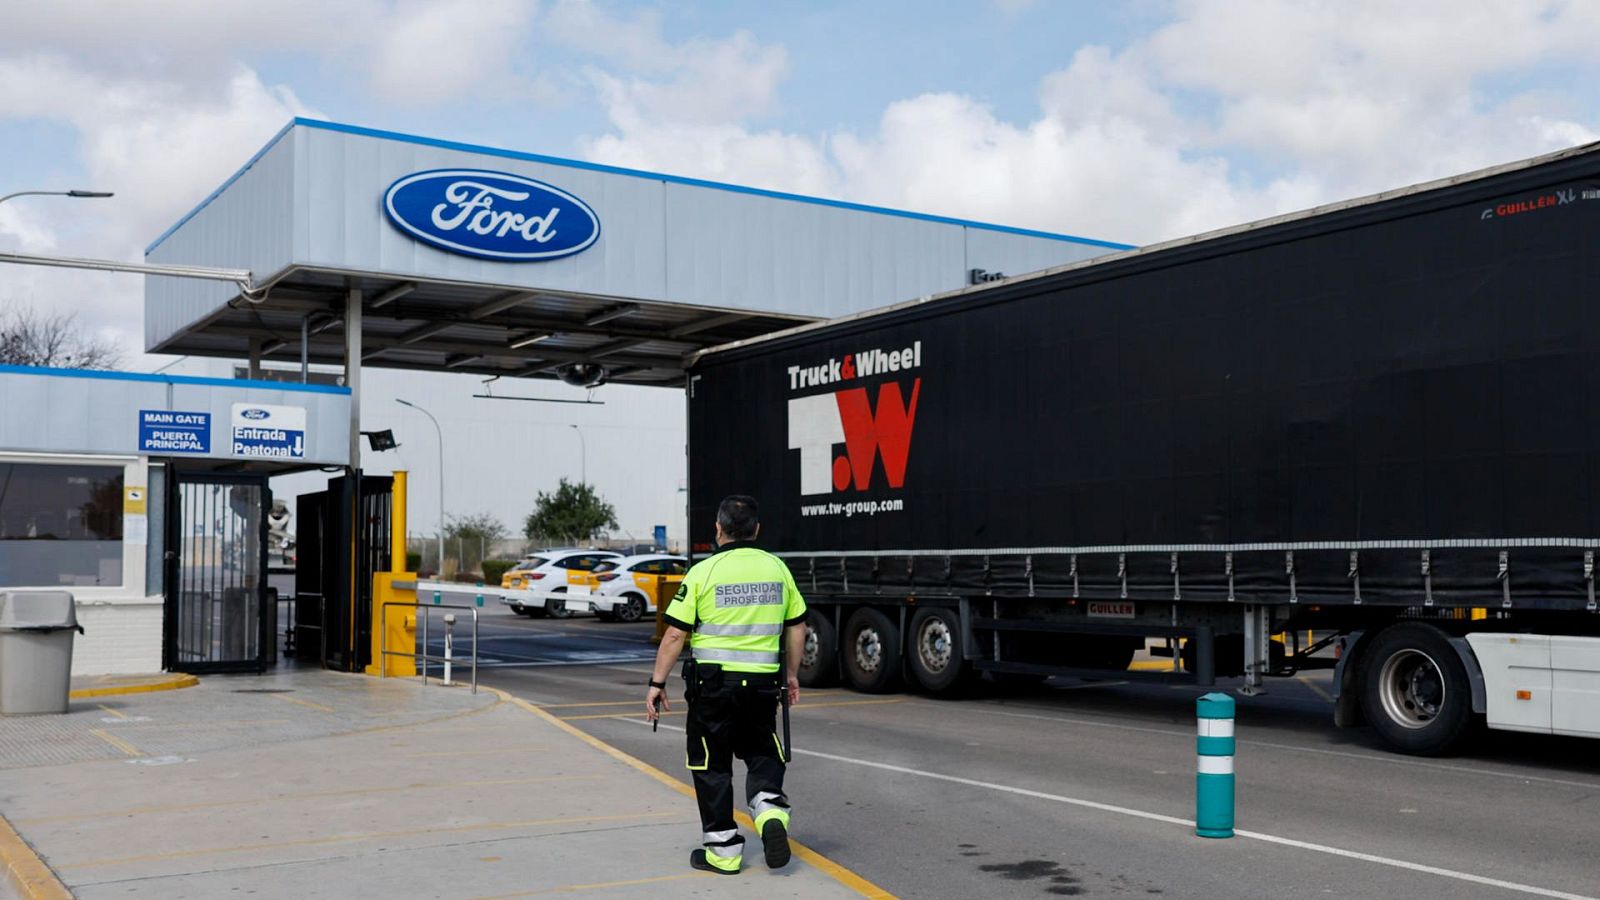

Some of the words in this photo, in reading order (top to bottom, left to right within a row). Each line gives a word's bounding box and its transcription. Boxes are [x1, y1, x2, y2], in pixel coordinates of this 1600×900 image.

[431, 180, 561, 243] Ford
[144, 413, 174, 423] MAIN
[175, 415, 206, 425] GATE
[152, 431, 198, 441] PUERTA
[234, 427, 287, 441] Entrada
[145, 440, 205, 450] PRINCIPAL
[234, 442, 292, 457] Peatonal
[801, 499, 904, 518] www.tw-group.com
[724, 594, 778, 605] PROSEGUR
